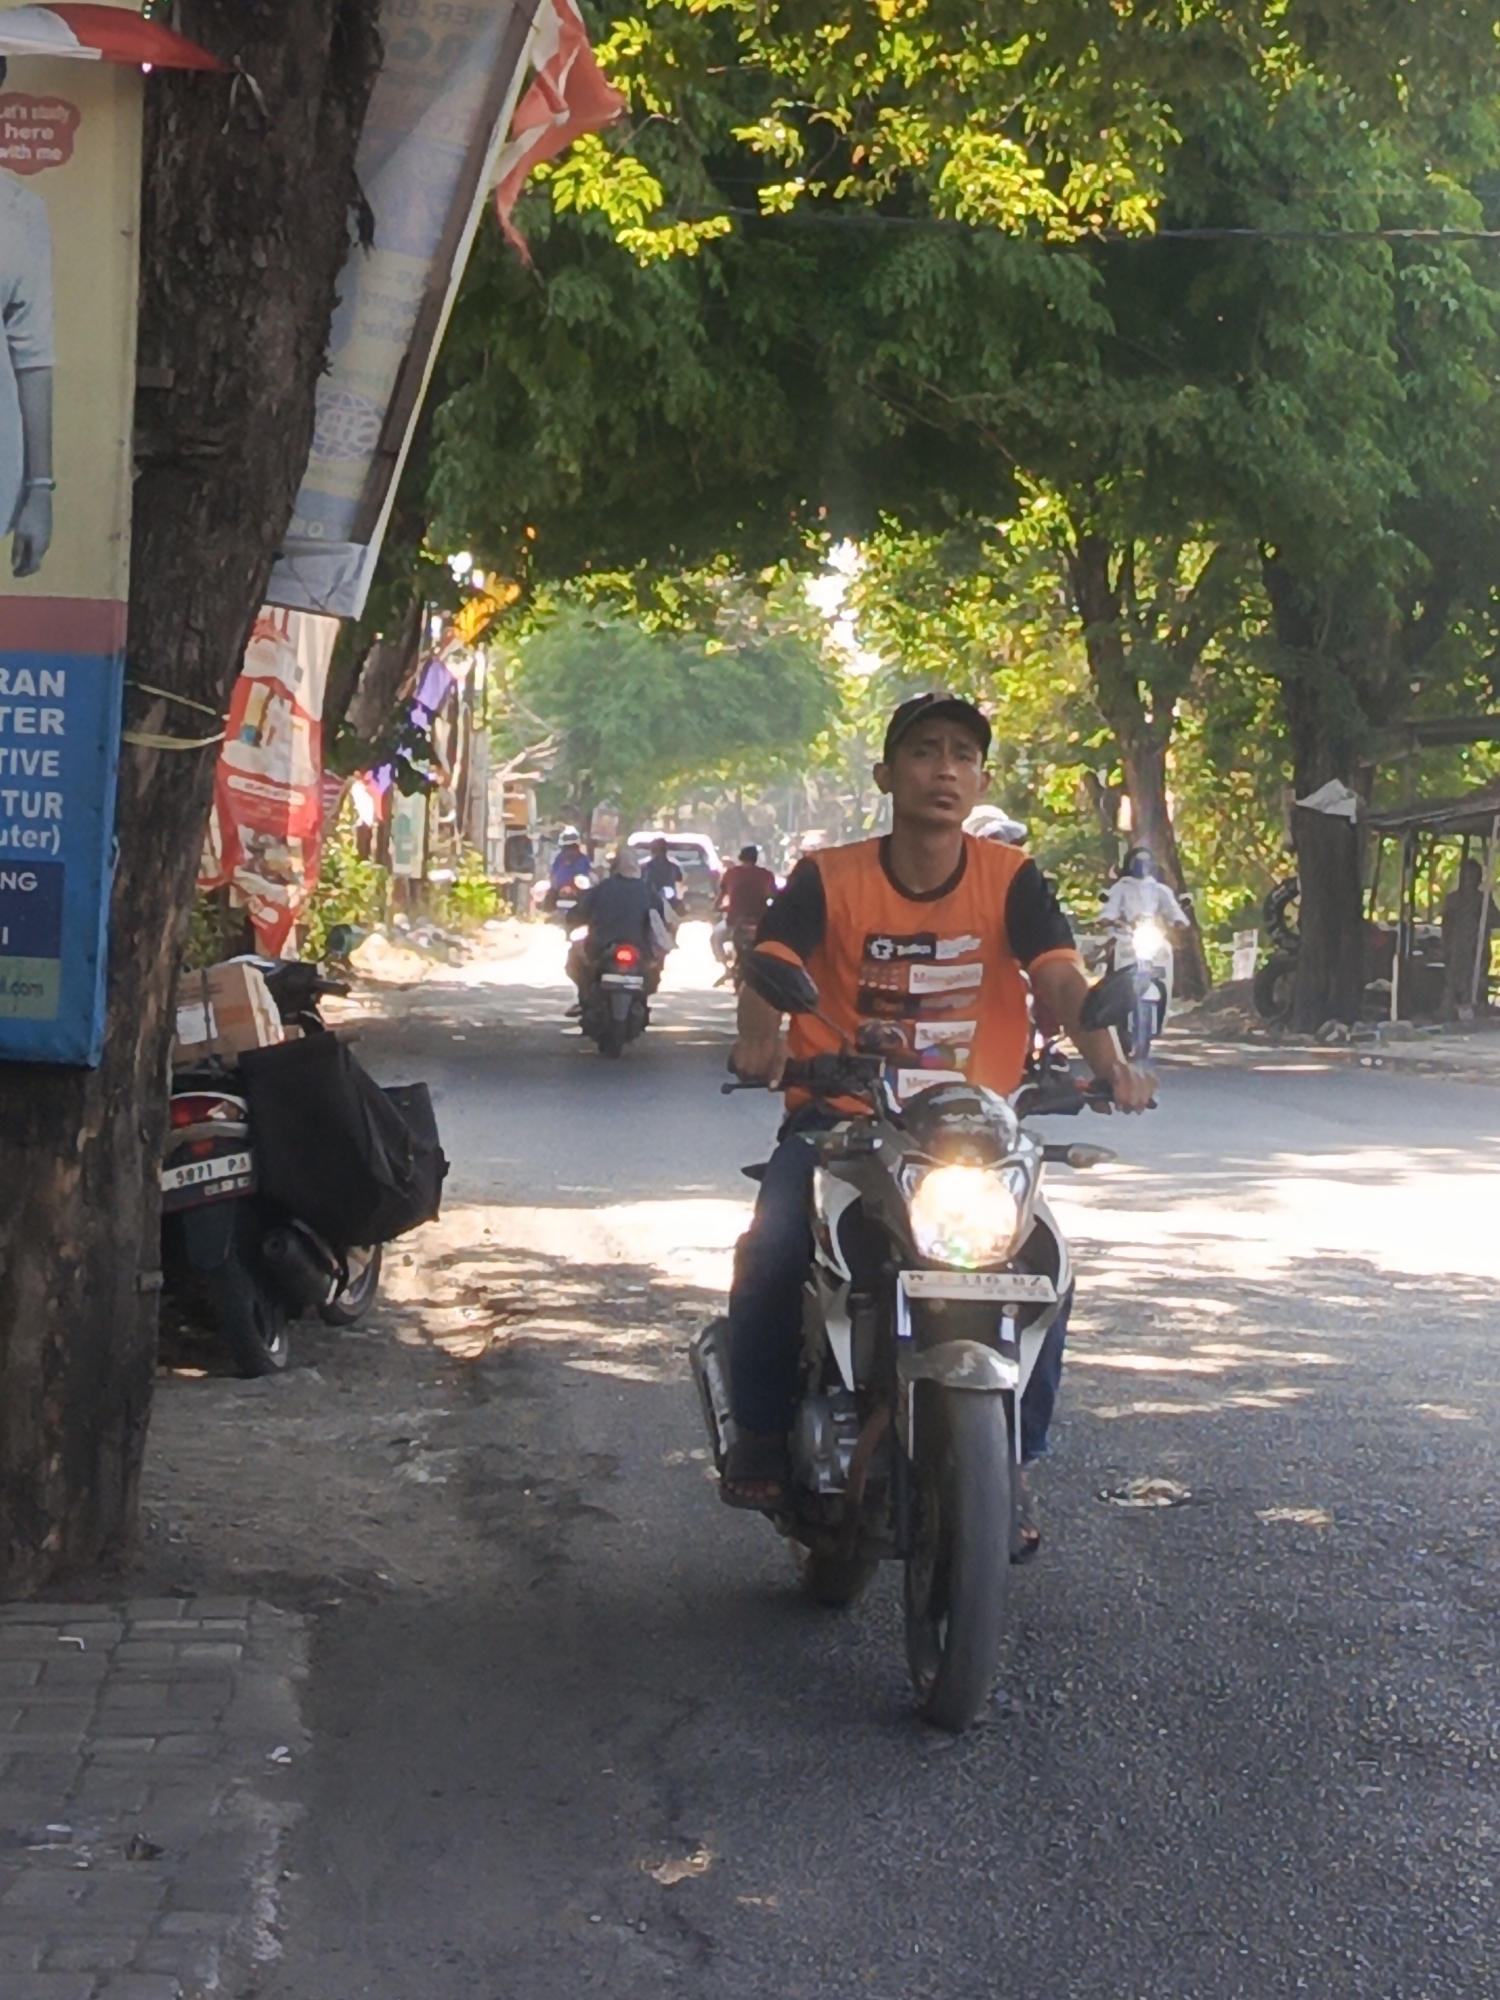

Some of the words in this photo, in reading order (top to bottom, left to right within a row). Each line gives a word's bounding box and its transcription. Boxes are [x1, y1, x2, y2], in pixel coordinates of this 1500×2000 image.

[5, 122, 54, 140] here
[36, 147, 62, 161] me
[1, 789, 63, 820] TUR
[0, 871, 38, 892] NG
